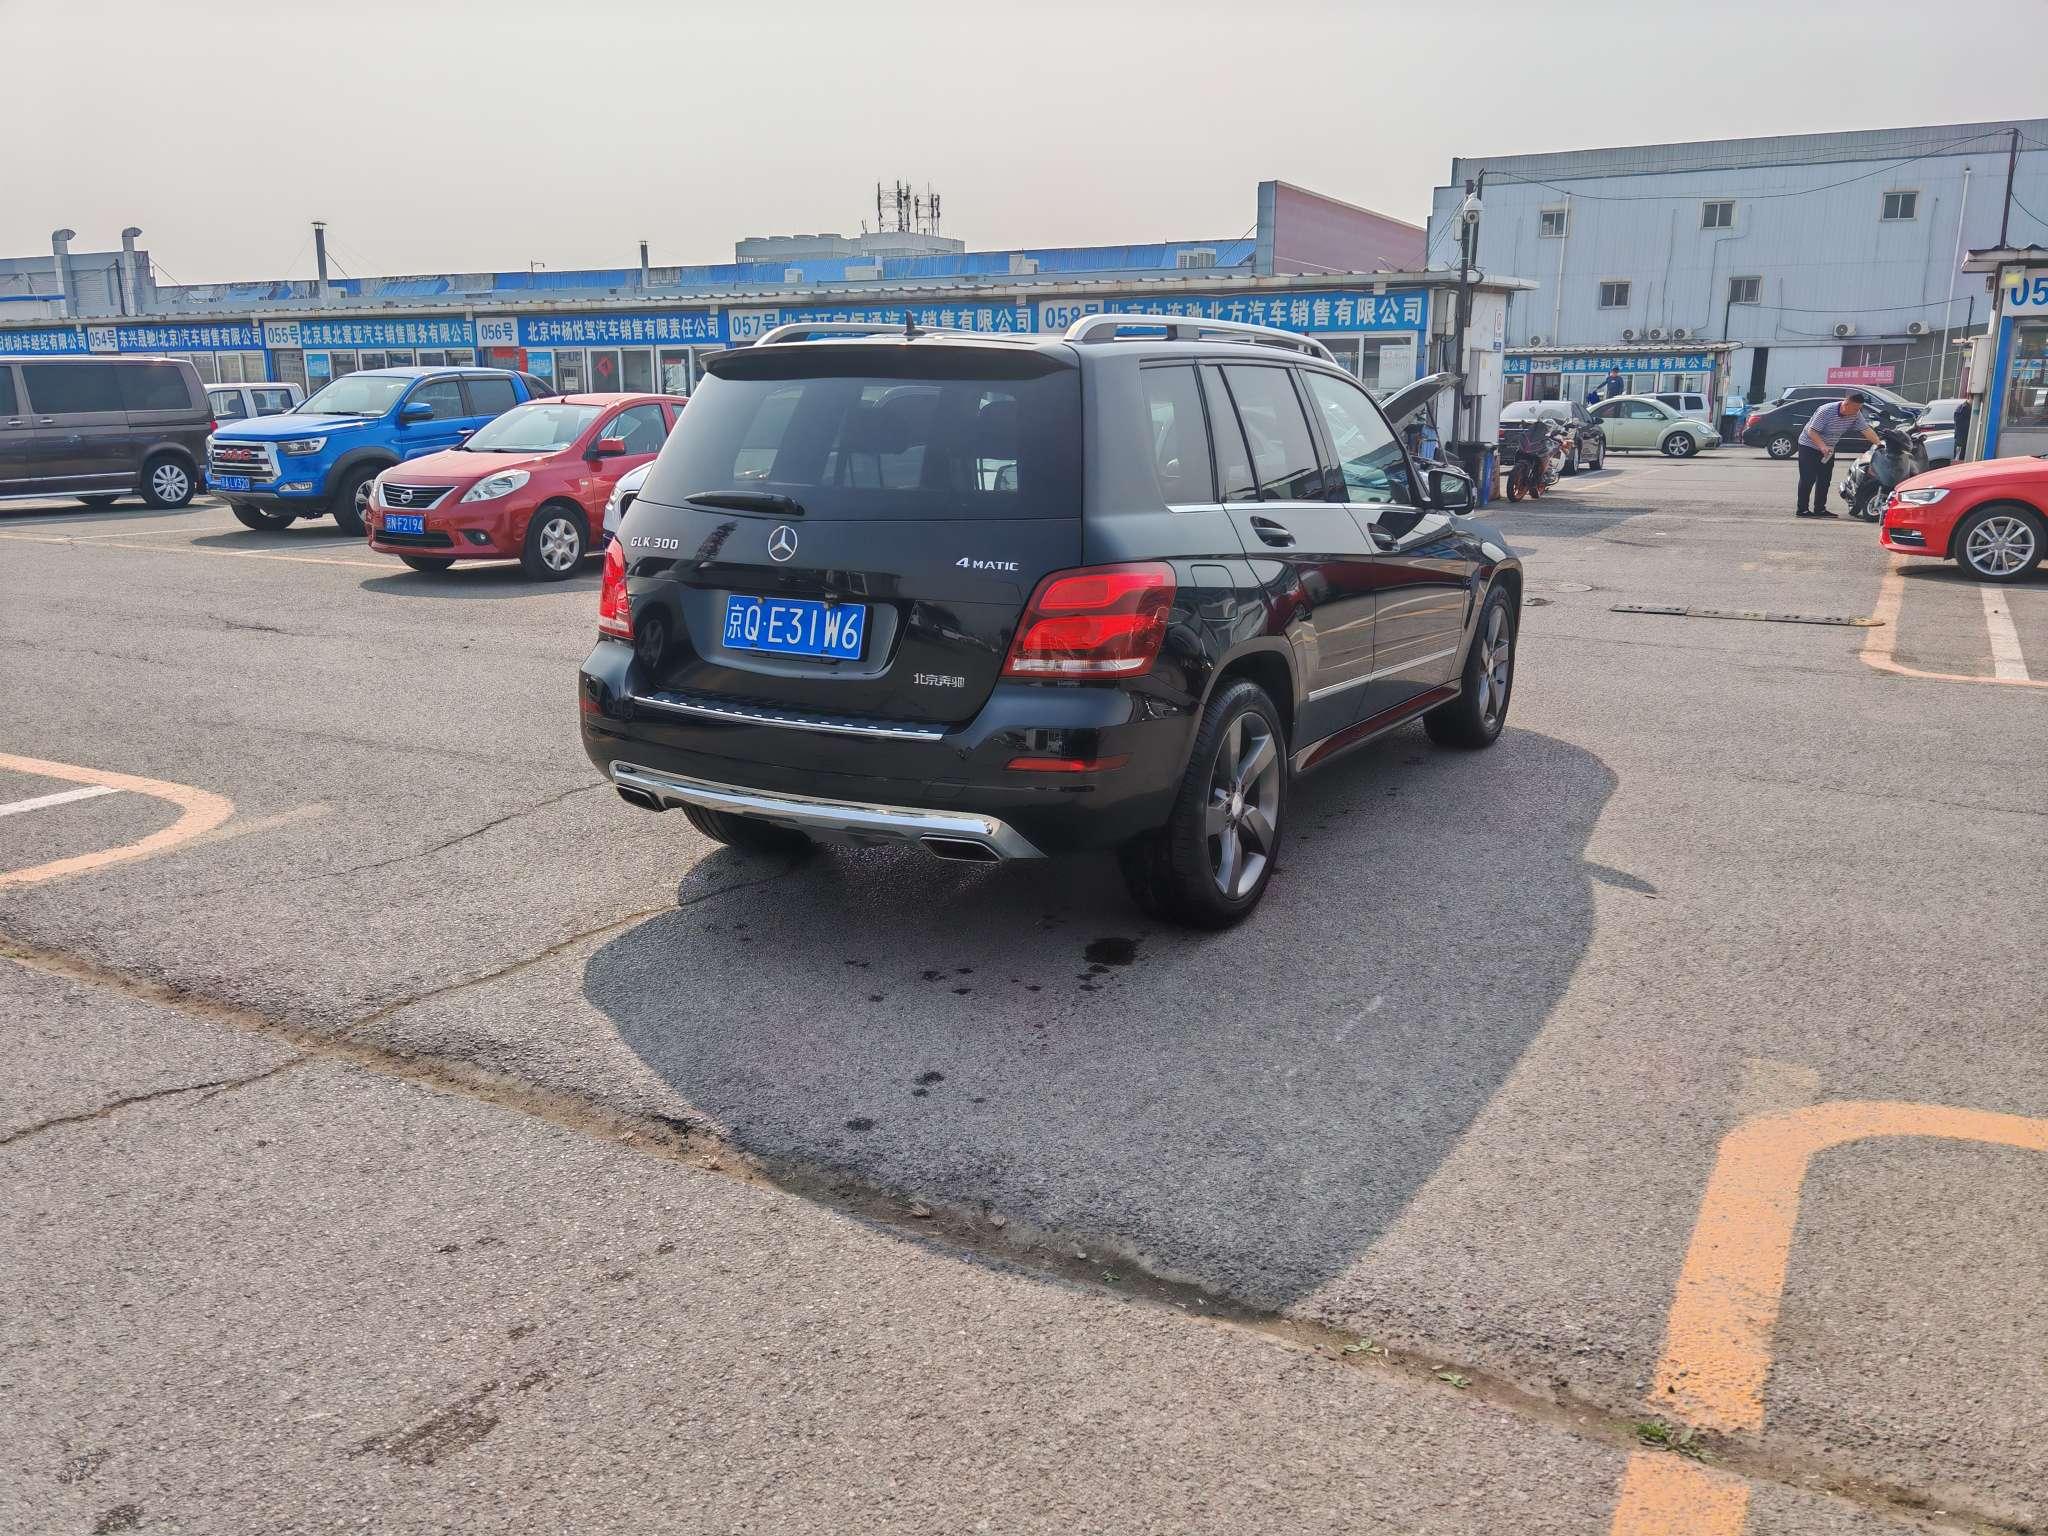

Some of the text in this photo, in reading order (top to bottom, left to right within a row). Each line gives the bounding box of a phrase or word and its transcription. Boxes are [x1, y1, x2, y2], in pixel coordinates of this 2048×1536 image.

[481, 322, 514, 341] 056号
[733, 314, 777, 335] 057号
[89, 330, 116, 347] 054号
[268, 325, 299, 345] 055号
[631, 537, 679, 550] GLK 300
[913, 673, 965, 688] 北京奔驰
